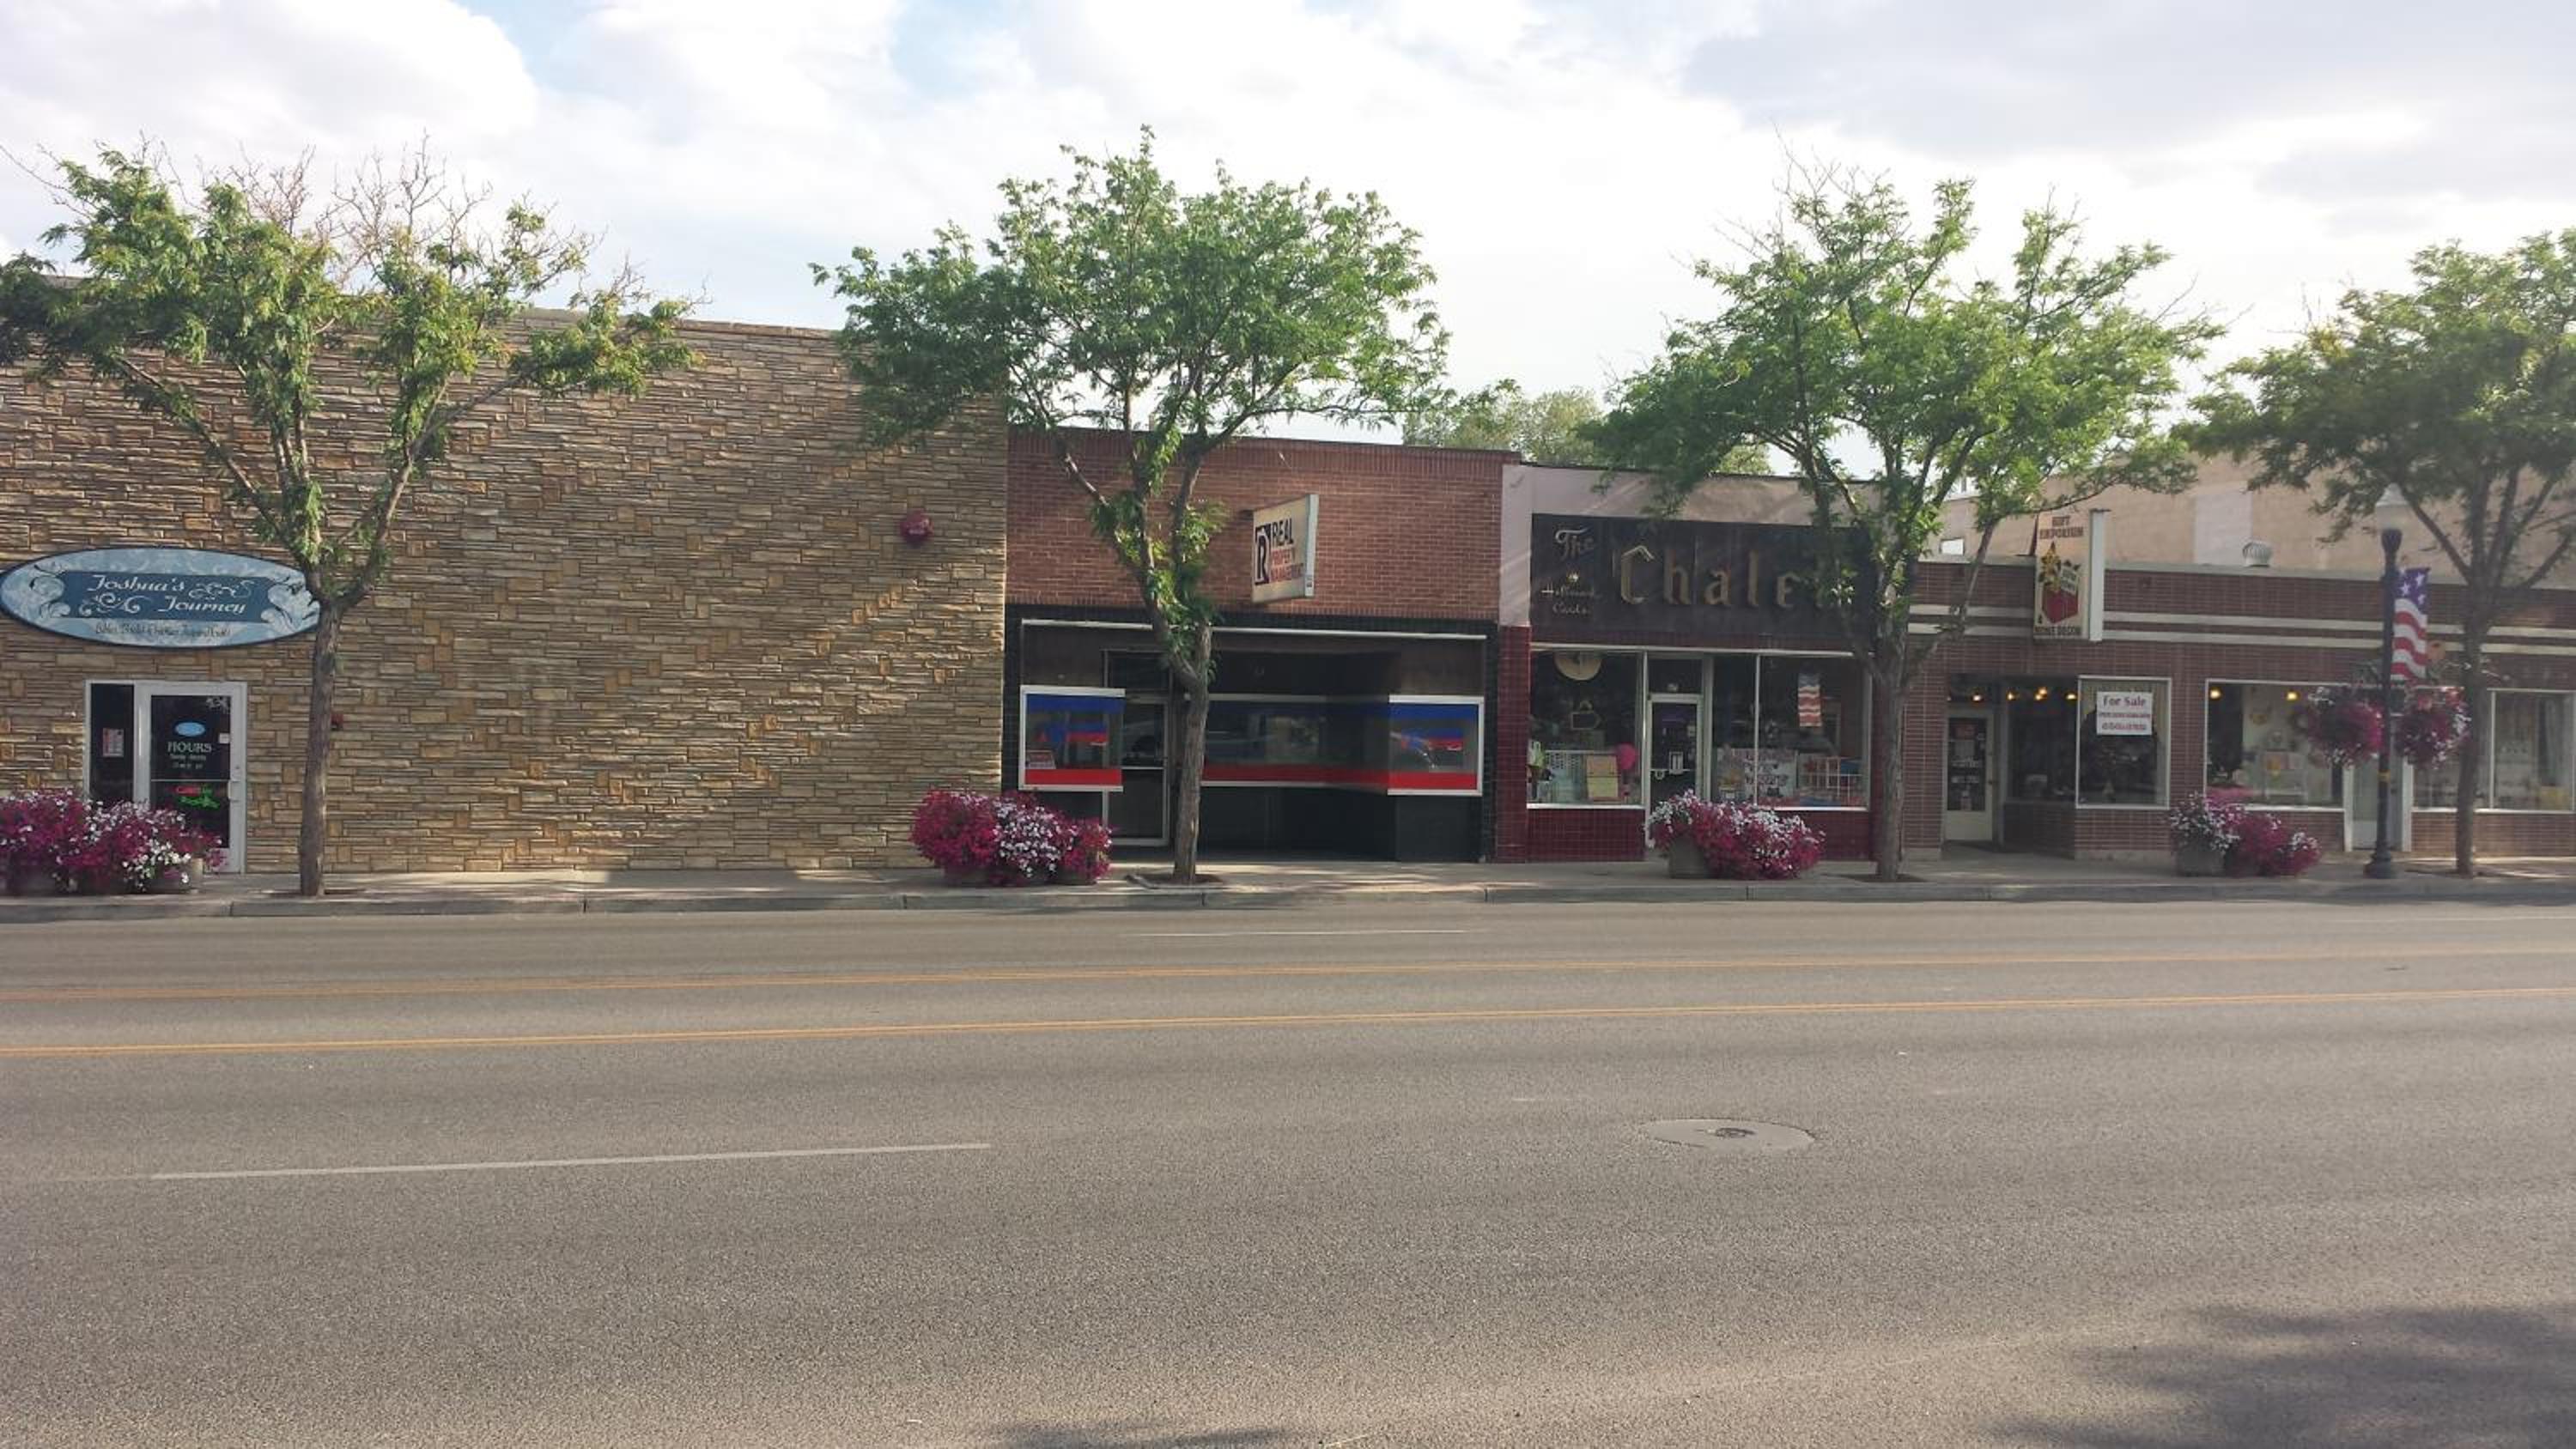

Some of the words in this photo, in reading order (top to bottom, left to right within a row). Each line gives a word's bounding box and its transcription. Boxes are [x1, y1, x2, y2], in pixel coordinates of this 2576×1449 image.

[1272, 518, 1294, 549] REAL
[1555, 527, 1595, 561] The
[88, 574, 185, 592] Joshua's
[157, 595, 247, 615] Journey
[2103, 695, 2121, 706] For
[2124, 694, 2147, 706] Sale
[167, 741, 212, 754] HOURS
